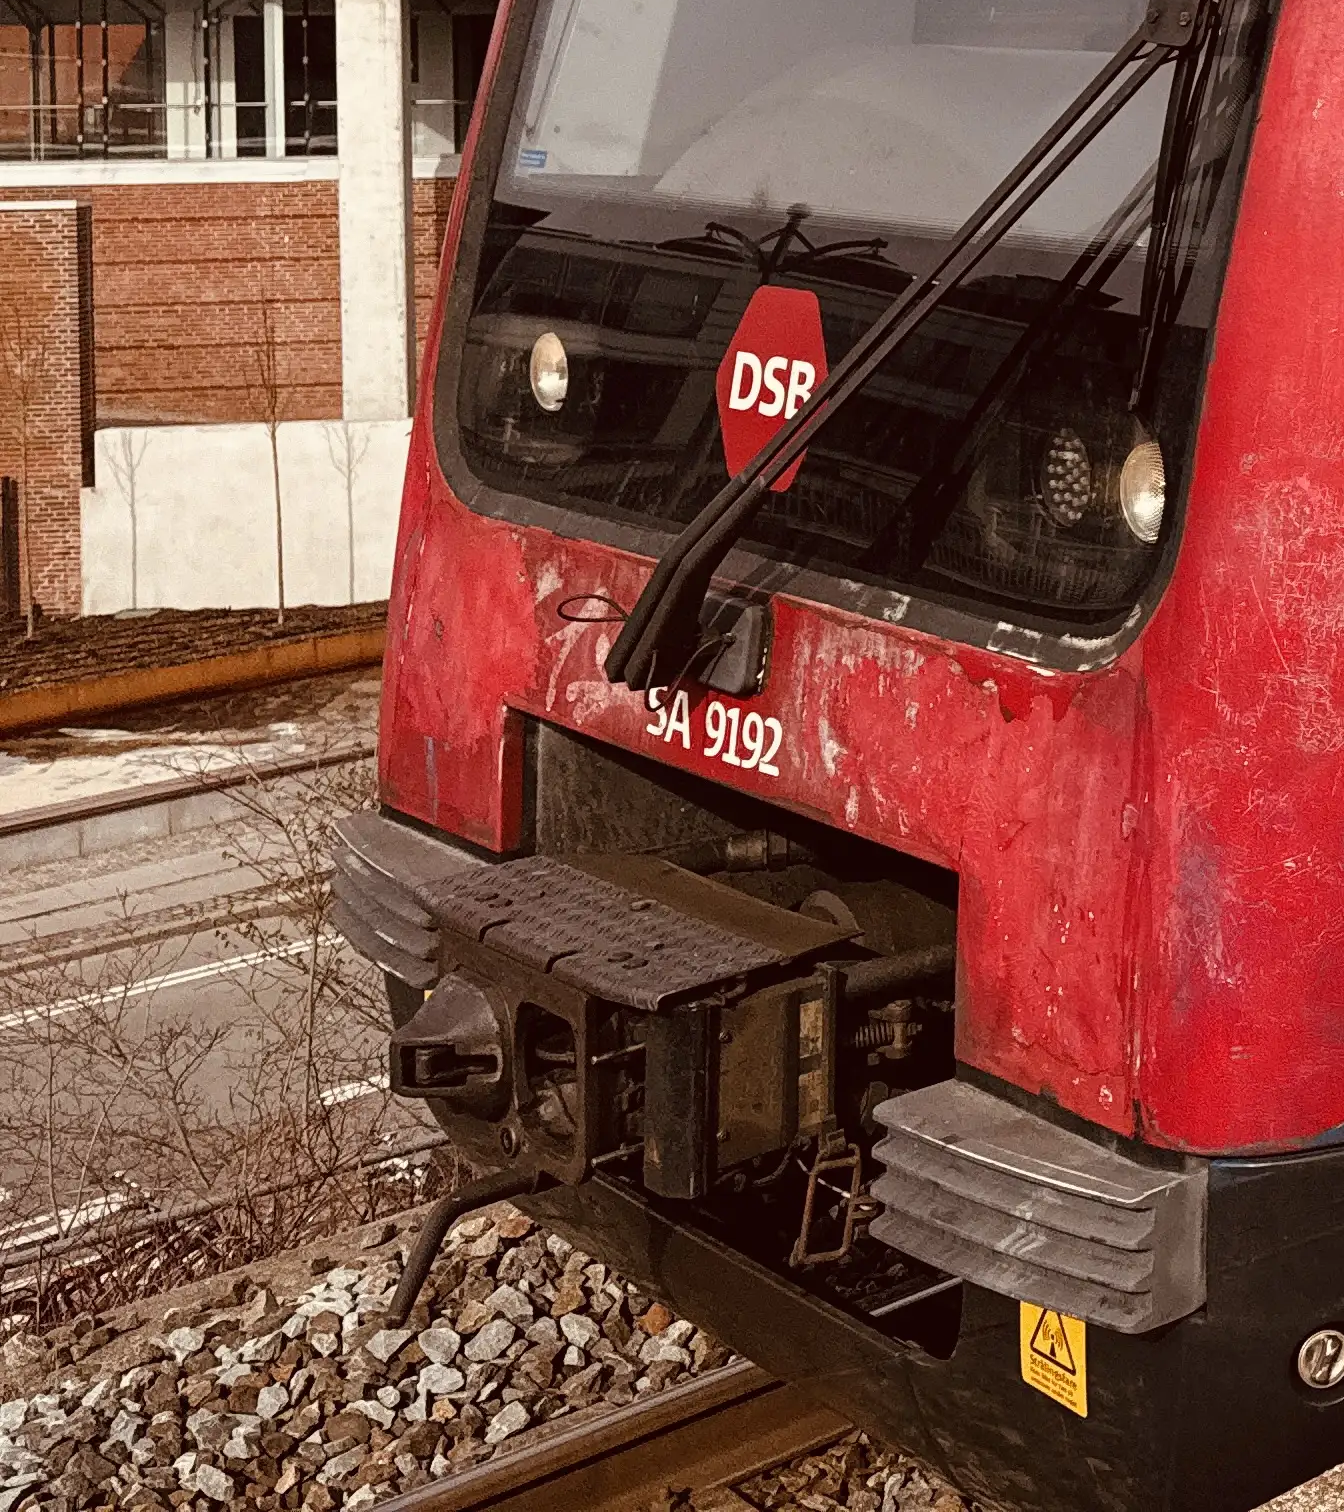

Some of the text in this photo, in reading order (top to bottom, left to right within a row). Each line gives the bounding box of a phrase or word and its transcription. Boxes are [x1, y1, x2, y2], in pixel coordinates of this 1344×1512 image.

[728, 350, 817, 421] DSB
[645, 685, 783, 777] SA 9192
